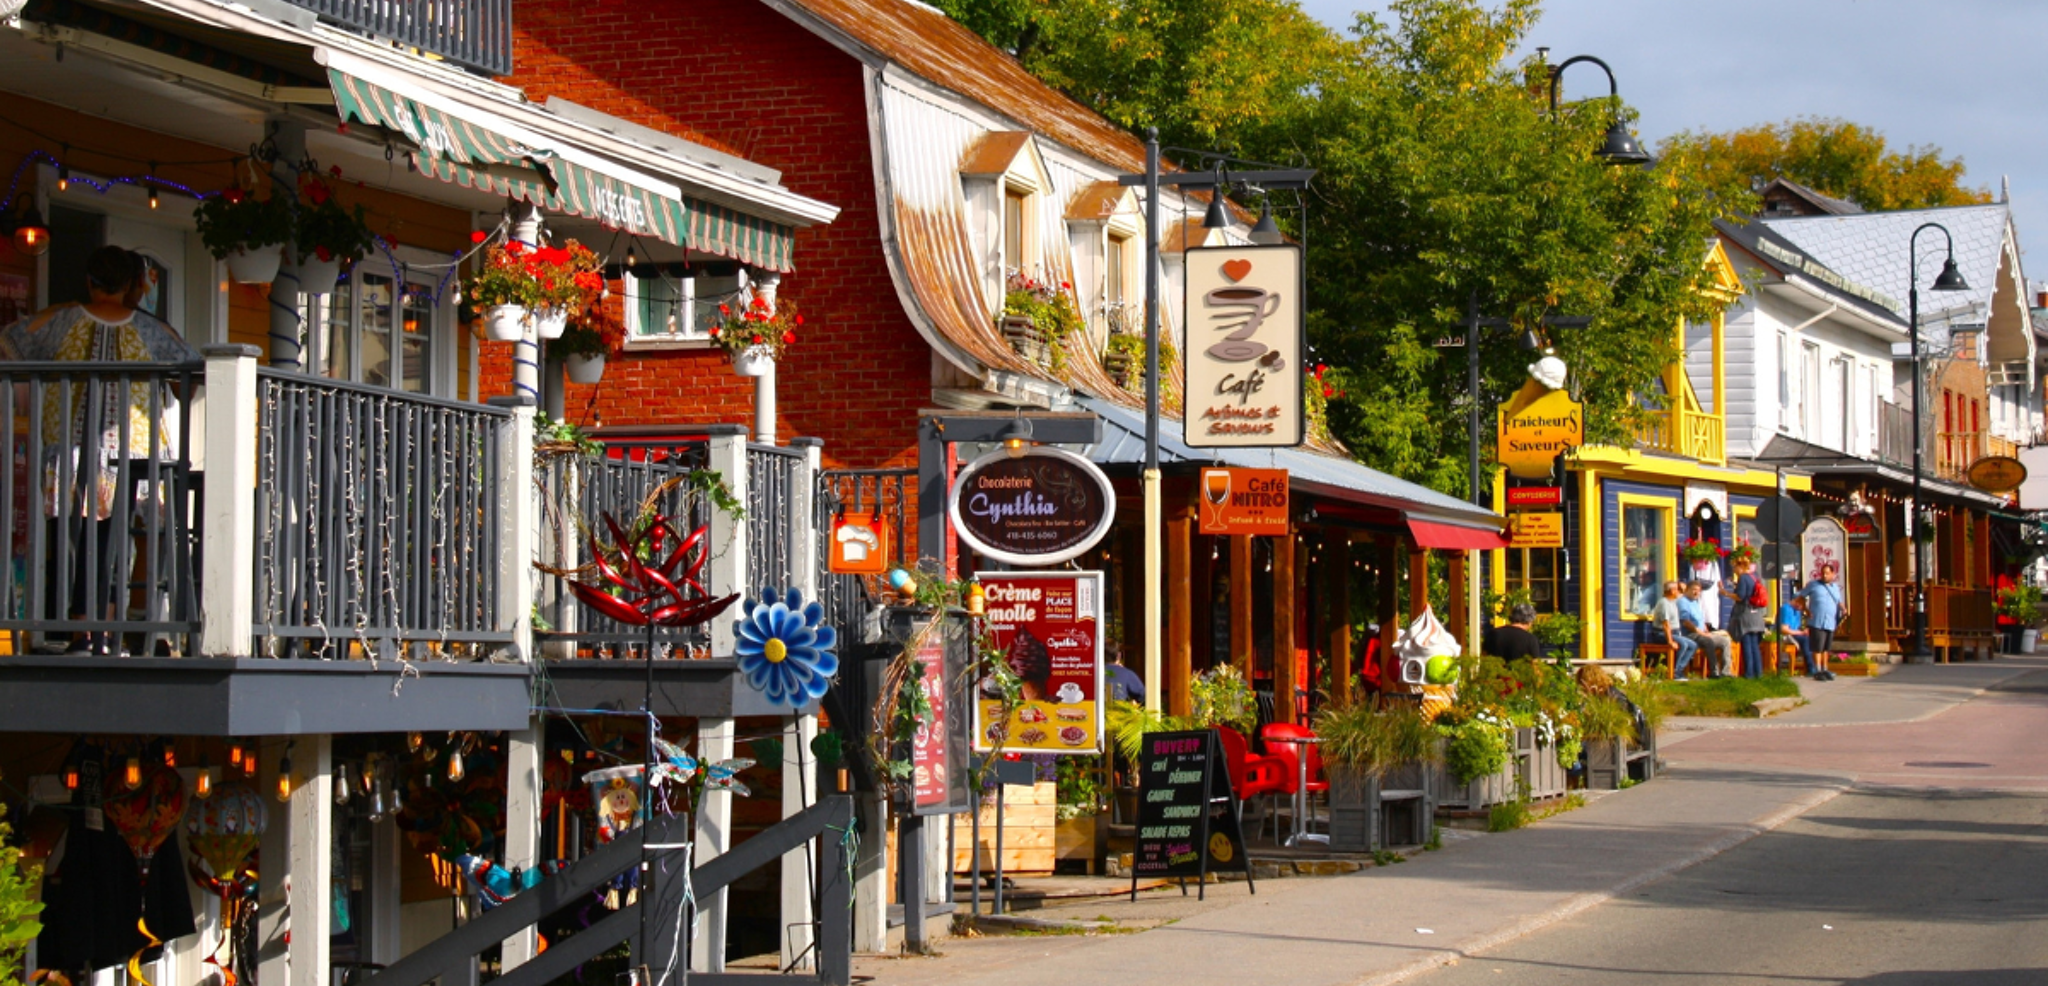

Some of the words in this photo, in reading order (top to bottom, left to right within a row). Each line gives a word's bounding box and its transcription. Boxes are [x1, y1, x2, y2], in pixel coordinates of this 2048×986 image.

[1217, 369, 1265, 404] Café
[978, 475, 1033, 489] Chocolaterie
[1247, 477, 1285, 493] Café
[1231, 492, 1287, 508] NITRO
[968, 490, 1059, 525] Cynthia
[1265, 516, 1287, 524] froid
[984, 582, 1042, 602] Crème
[1045, 597, 1072, 606] PLACE
[987, 603, 1037, 622] molle
[1045, 605, 1054, 613] de
[1054, 606, 1072, 614] façon
[1047, 637, 1079, 651] Cynthia
[1153, 739, 1200, 754] OUVERT
[1162, 805, 1202, 818] SANDWICH
[1140, 825, 1167, 839] SALADE
